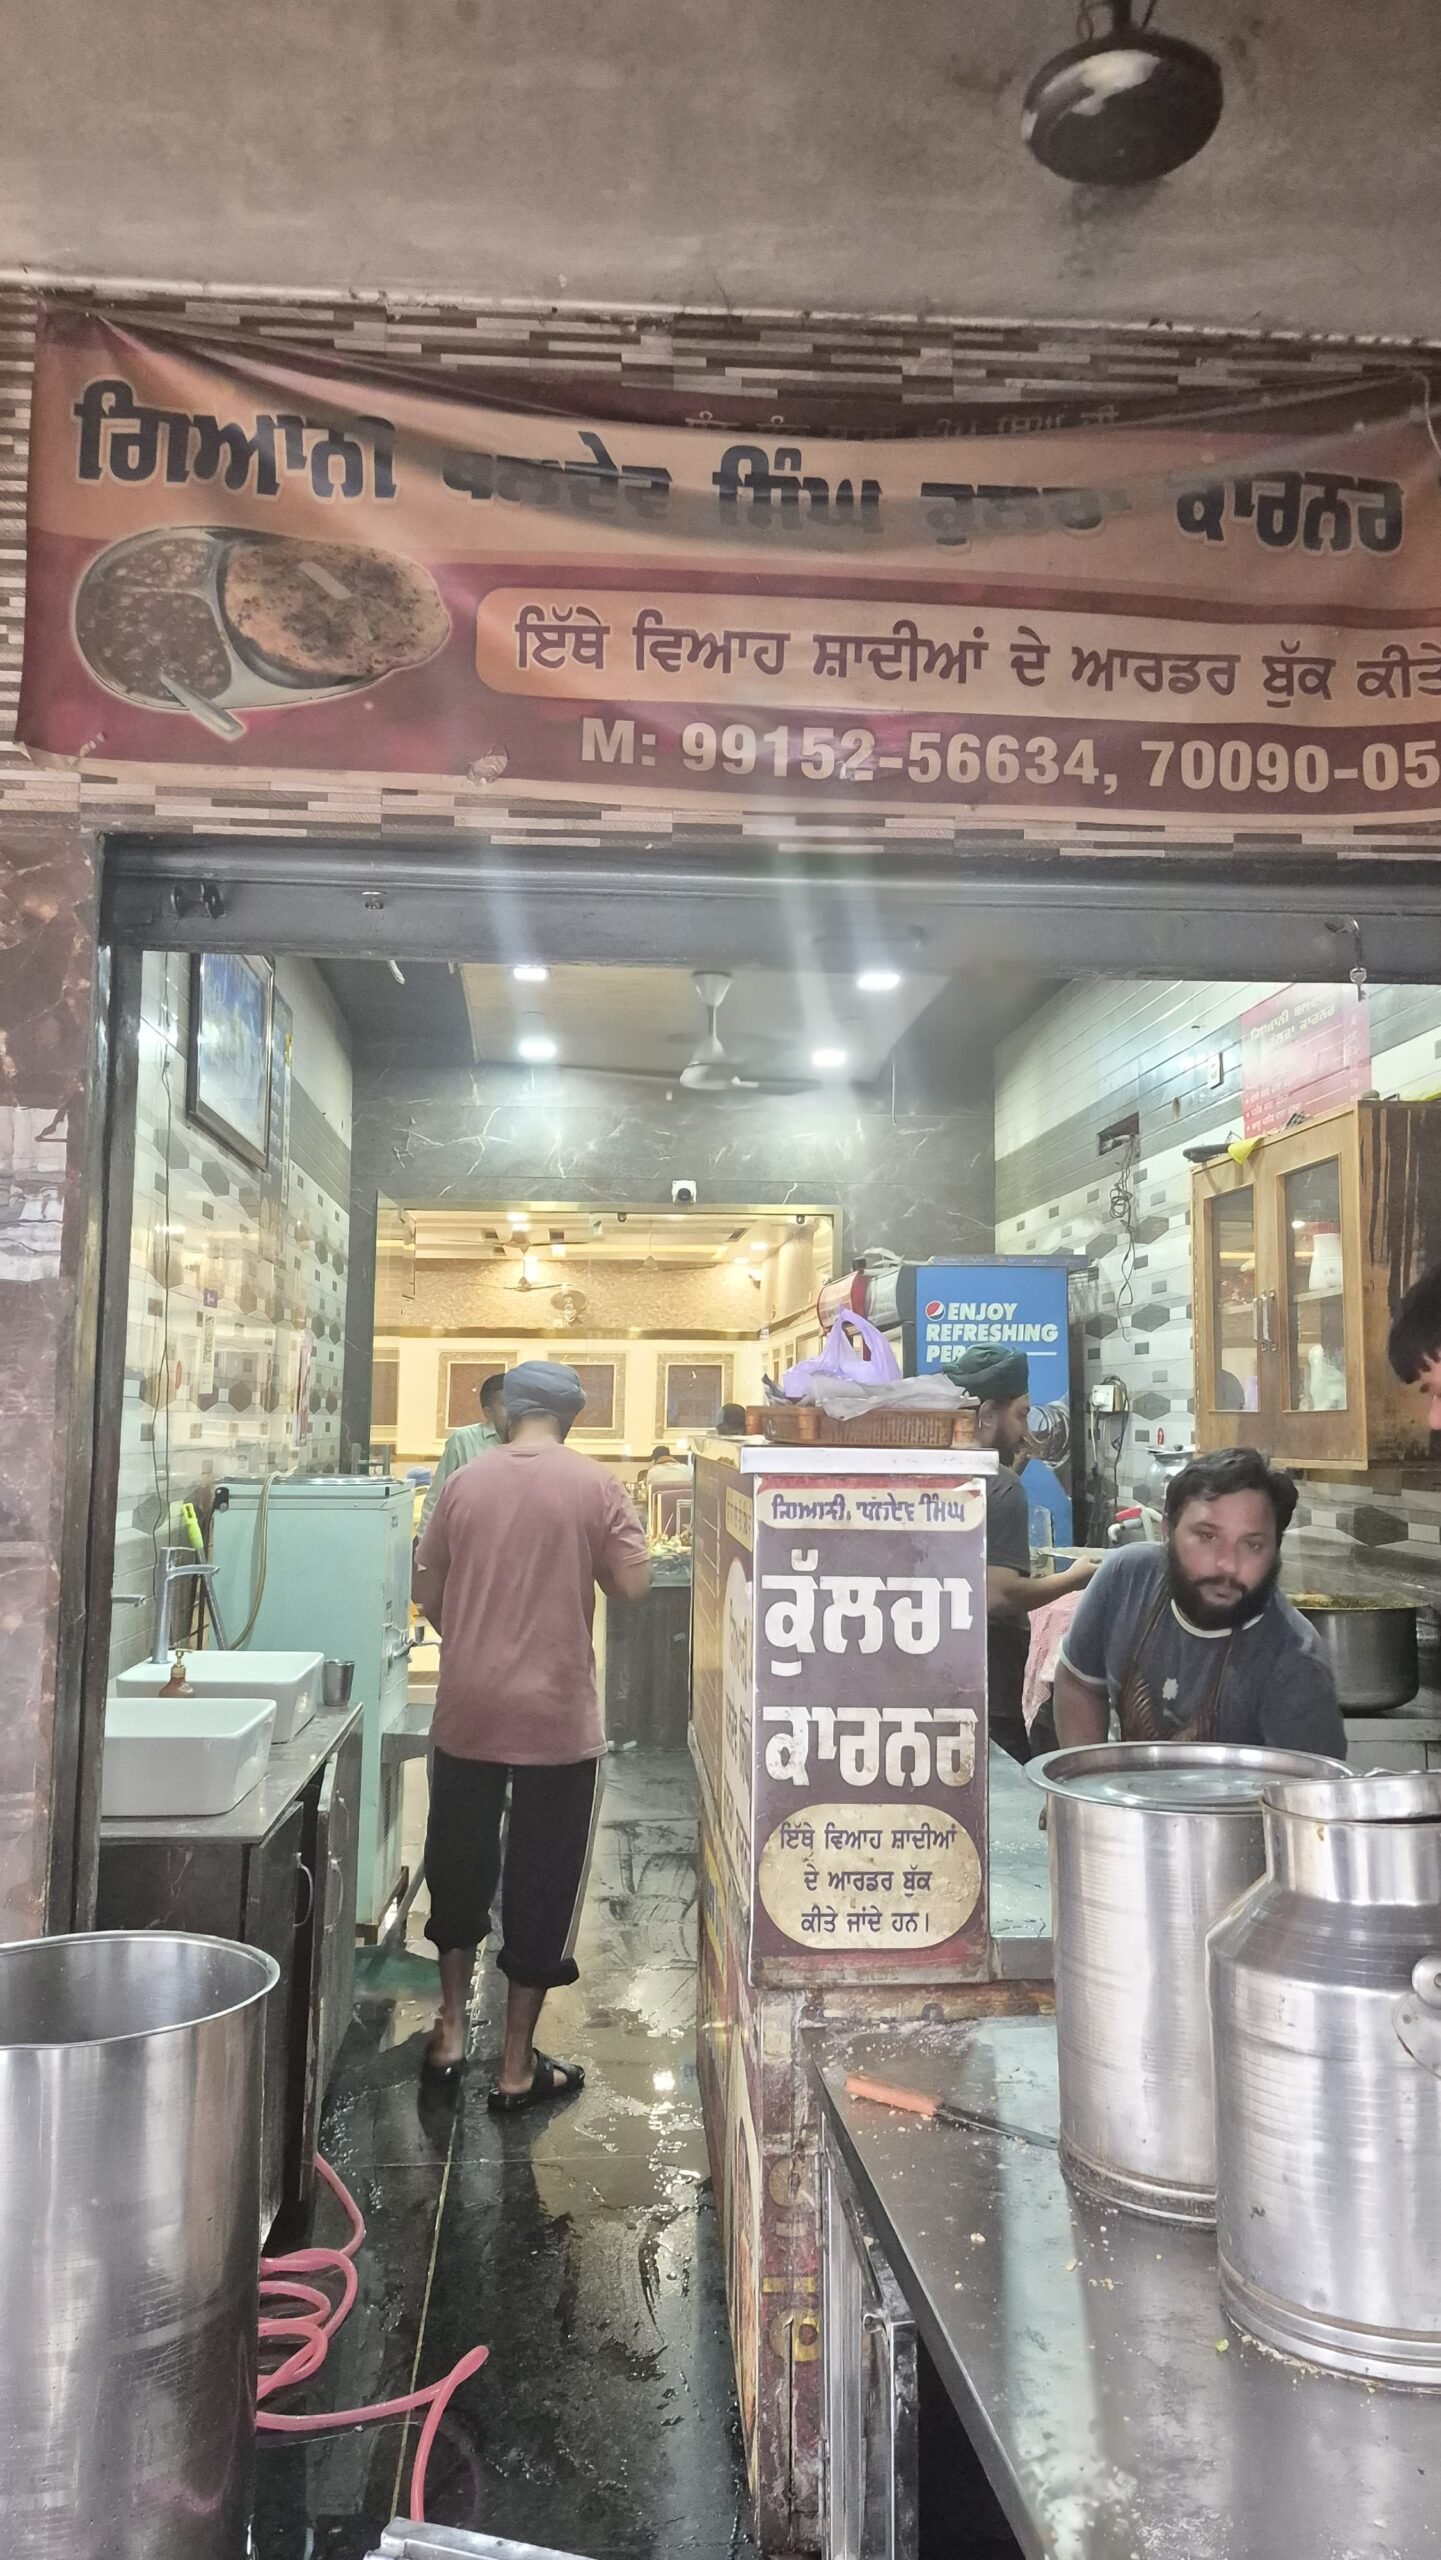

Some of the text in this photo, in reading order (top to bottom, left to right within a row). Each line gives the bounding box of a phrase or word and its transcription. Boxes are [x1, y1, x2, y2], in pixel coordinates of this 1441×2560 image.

[74, 380, 397, 498] ਗਿਆਨੀ
[1177, 470, 1405, 552] ਕਾਰਨਰ
[515, 605, 610, 669] ਇੱਥੇ
[632, 608, 790, 675] ਵਿਆਹ
[813, 620, 989, 684] ਸ਼ਾਦੀਆਂ
[1010, 625, 1050, 687] ਦੇ
[1072, 646, 1241, 696] ਆਰਡਰ
[1262, 639, 1336, 708] ਬੁੱਕ
[582, 717, 1440, 795] M: 99152-56634, 70090-05
[947, 1302, 1018, 1321] ENJOY
[925, 1323, 1059, 1343] REFRESHING
[926, 1344, 967, 1363] PER
[762, 1548, 973, 1677] ਕੁੱਲਚਾ
[763, 1706, 979, 1787] ਕਾਰਨਰ
[780, 1821, 957, 1850] ਇੱਥੇ ਵਿਆਹ ਸ਼ਾਦੀਆਂ
[804, 1863, 932, 1897] ਦੇ ਆਰਡਰ ਬੁੱਕ
[801, 1905, 838, 1933] ਕੀਤੇ
[847, 1905, 883, 1933] ਜਾਂਦੇ
